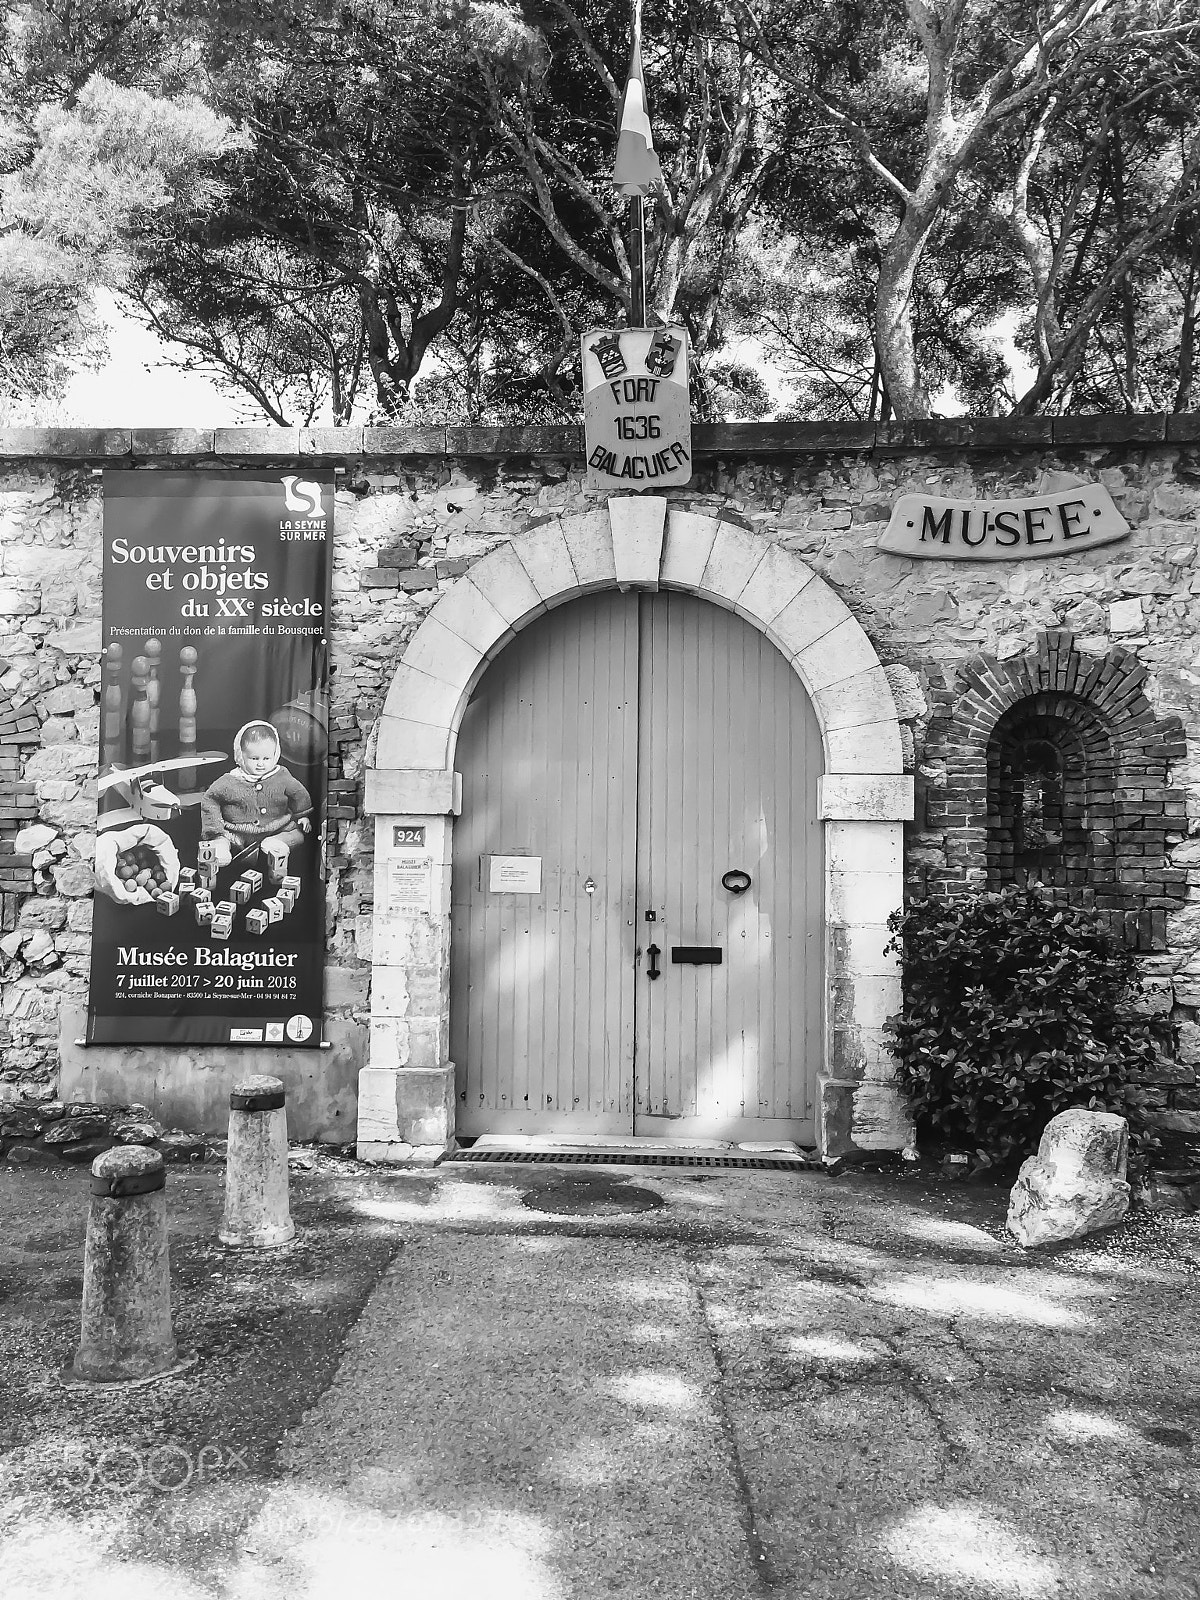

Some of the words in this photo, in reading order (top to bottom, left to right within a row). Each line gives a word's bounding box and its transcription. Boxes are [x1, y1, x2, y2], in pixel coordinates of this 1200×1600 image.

[610, 378, 660, 405] FORT
[614, 415, 660, 440] 1636
[588, 441, 690, 479] BALAGUIER
[280, 520, 292, 530] LA
[294, 520, 327, 530] SEYNE
[280, 531, 301, 541] SUR
[303, 531, 326, 541] MER
[111, 537, 256, 564] Souvenirs
[145, 567, 174, 591] et
[182, 564, 269, 596] objets
[180, 598, 209, 618] du
[261, 596, 323, 617] siècle
[109, 625, 167, 636] Présentation
[169, 625, 181, 636] du
[183, 625, 201, 636] don
[203, 625, 216, 636] de
[217, 625, 226, 636] la
[227, 624, 261, 636] famille
[262, 624, 275, 636] du
[277, 624, 324, 638] Bousquet
[397, 830, 422, 843] 924
[116, 946, 188, 967] Musée
[194, 947, 298, 971] Balaguier
[116, 974, 126, 987] 7
[128, 974, 169, 990] juillet
[170, 975, 200, 988] 2017
[214, 975, 234, 988] 20
[236, 975, 264, 990] juin
[267, 976, 297, 989] 2018
